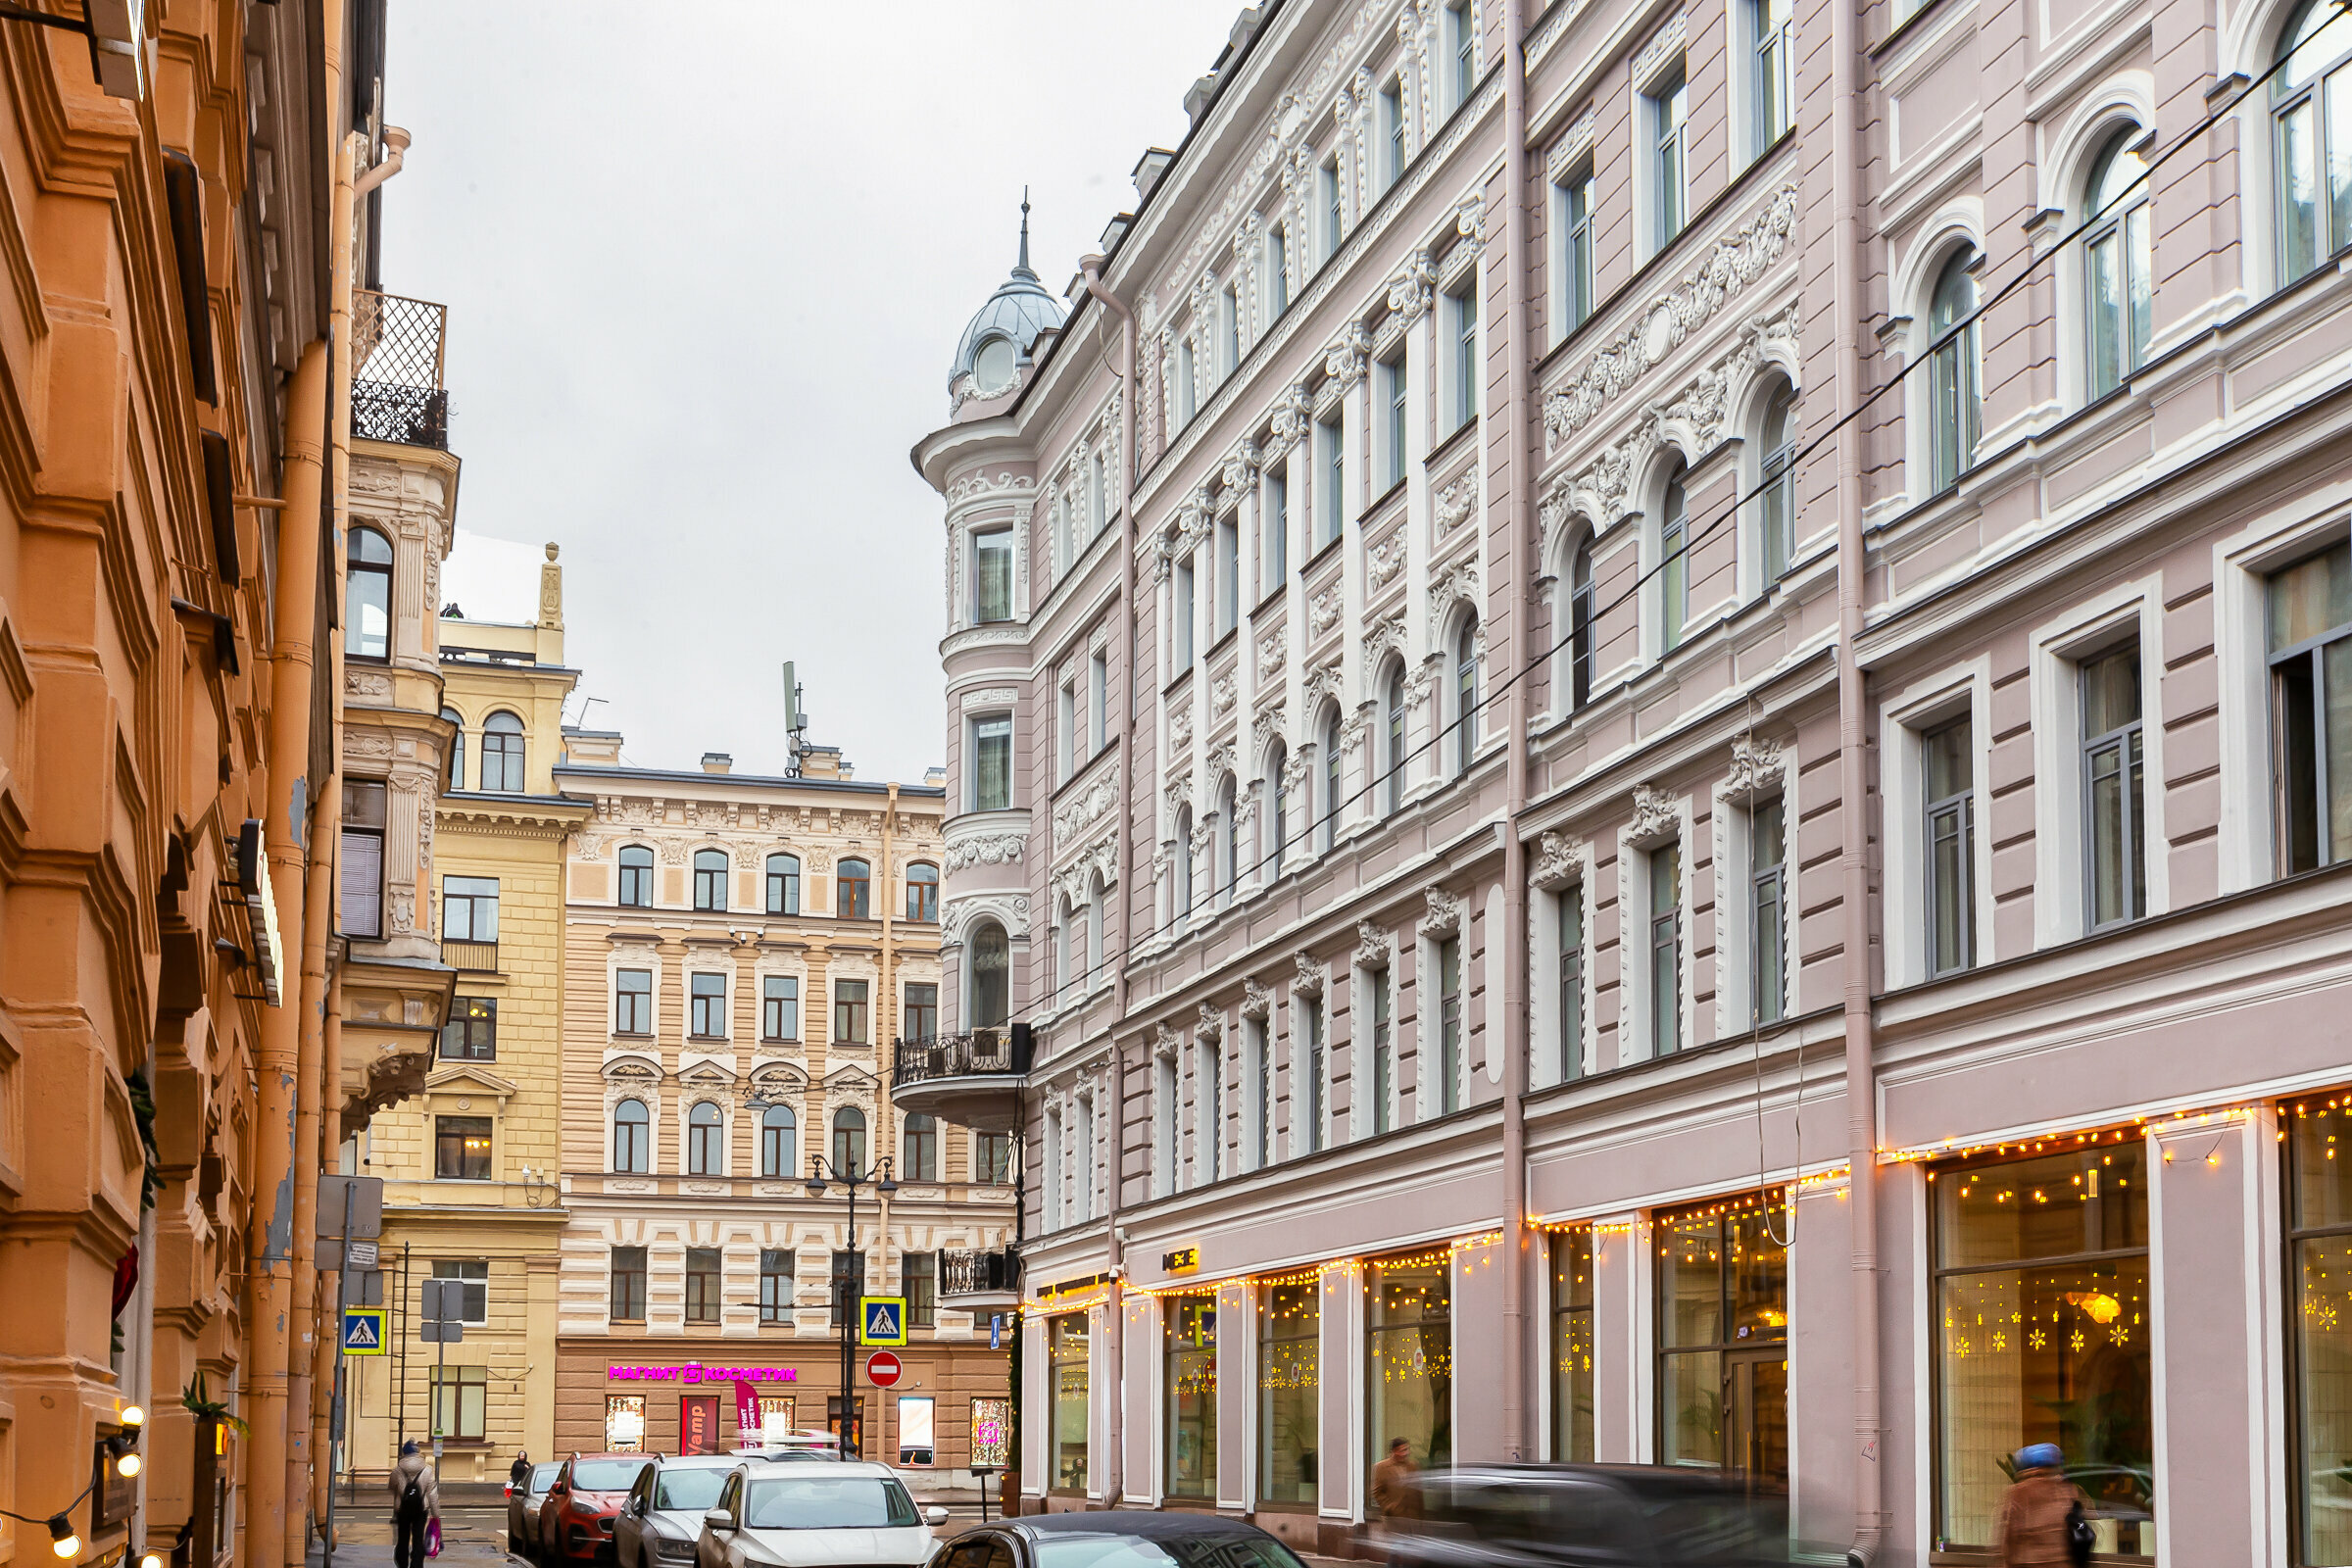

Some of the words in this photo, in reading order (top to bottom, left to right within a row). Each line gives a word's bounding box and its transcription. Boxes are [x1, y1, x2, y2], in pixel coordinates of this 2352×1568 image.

[609, 1366, 680, 1381] МАГНИТ
[704, 1367, 798, 1382] КОСМЕТИК
[688, 1405, 706, 1455] Vamp
